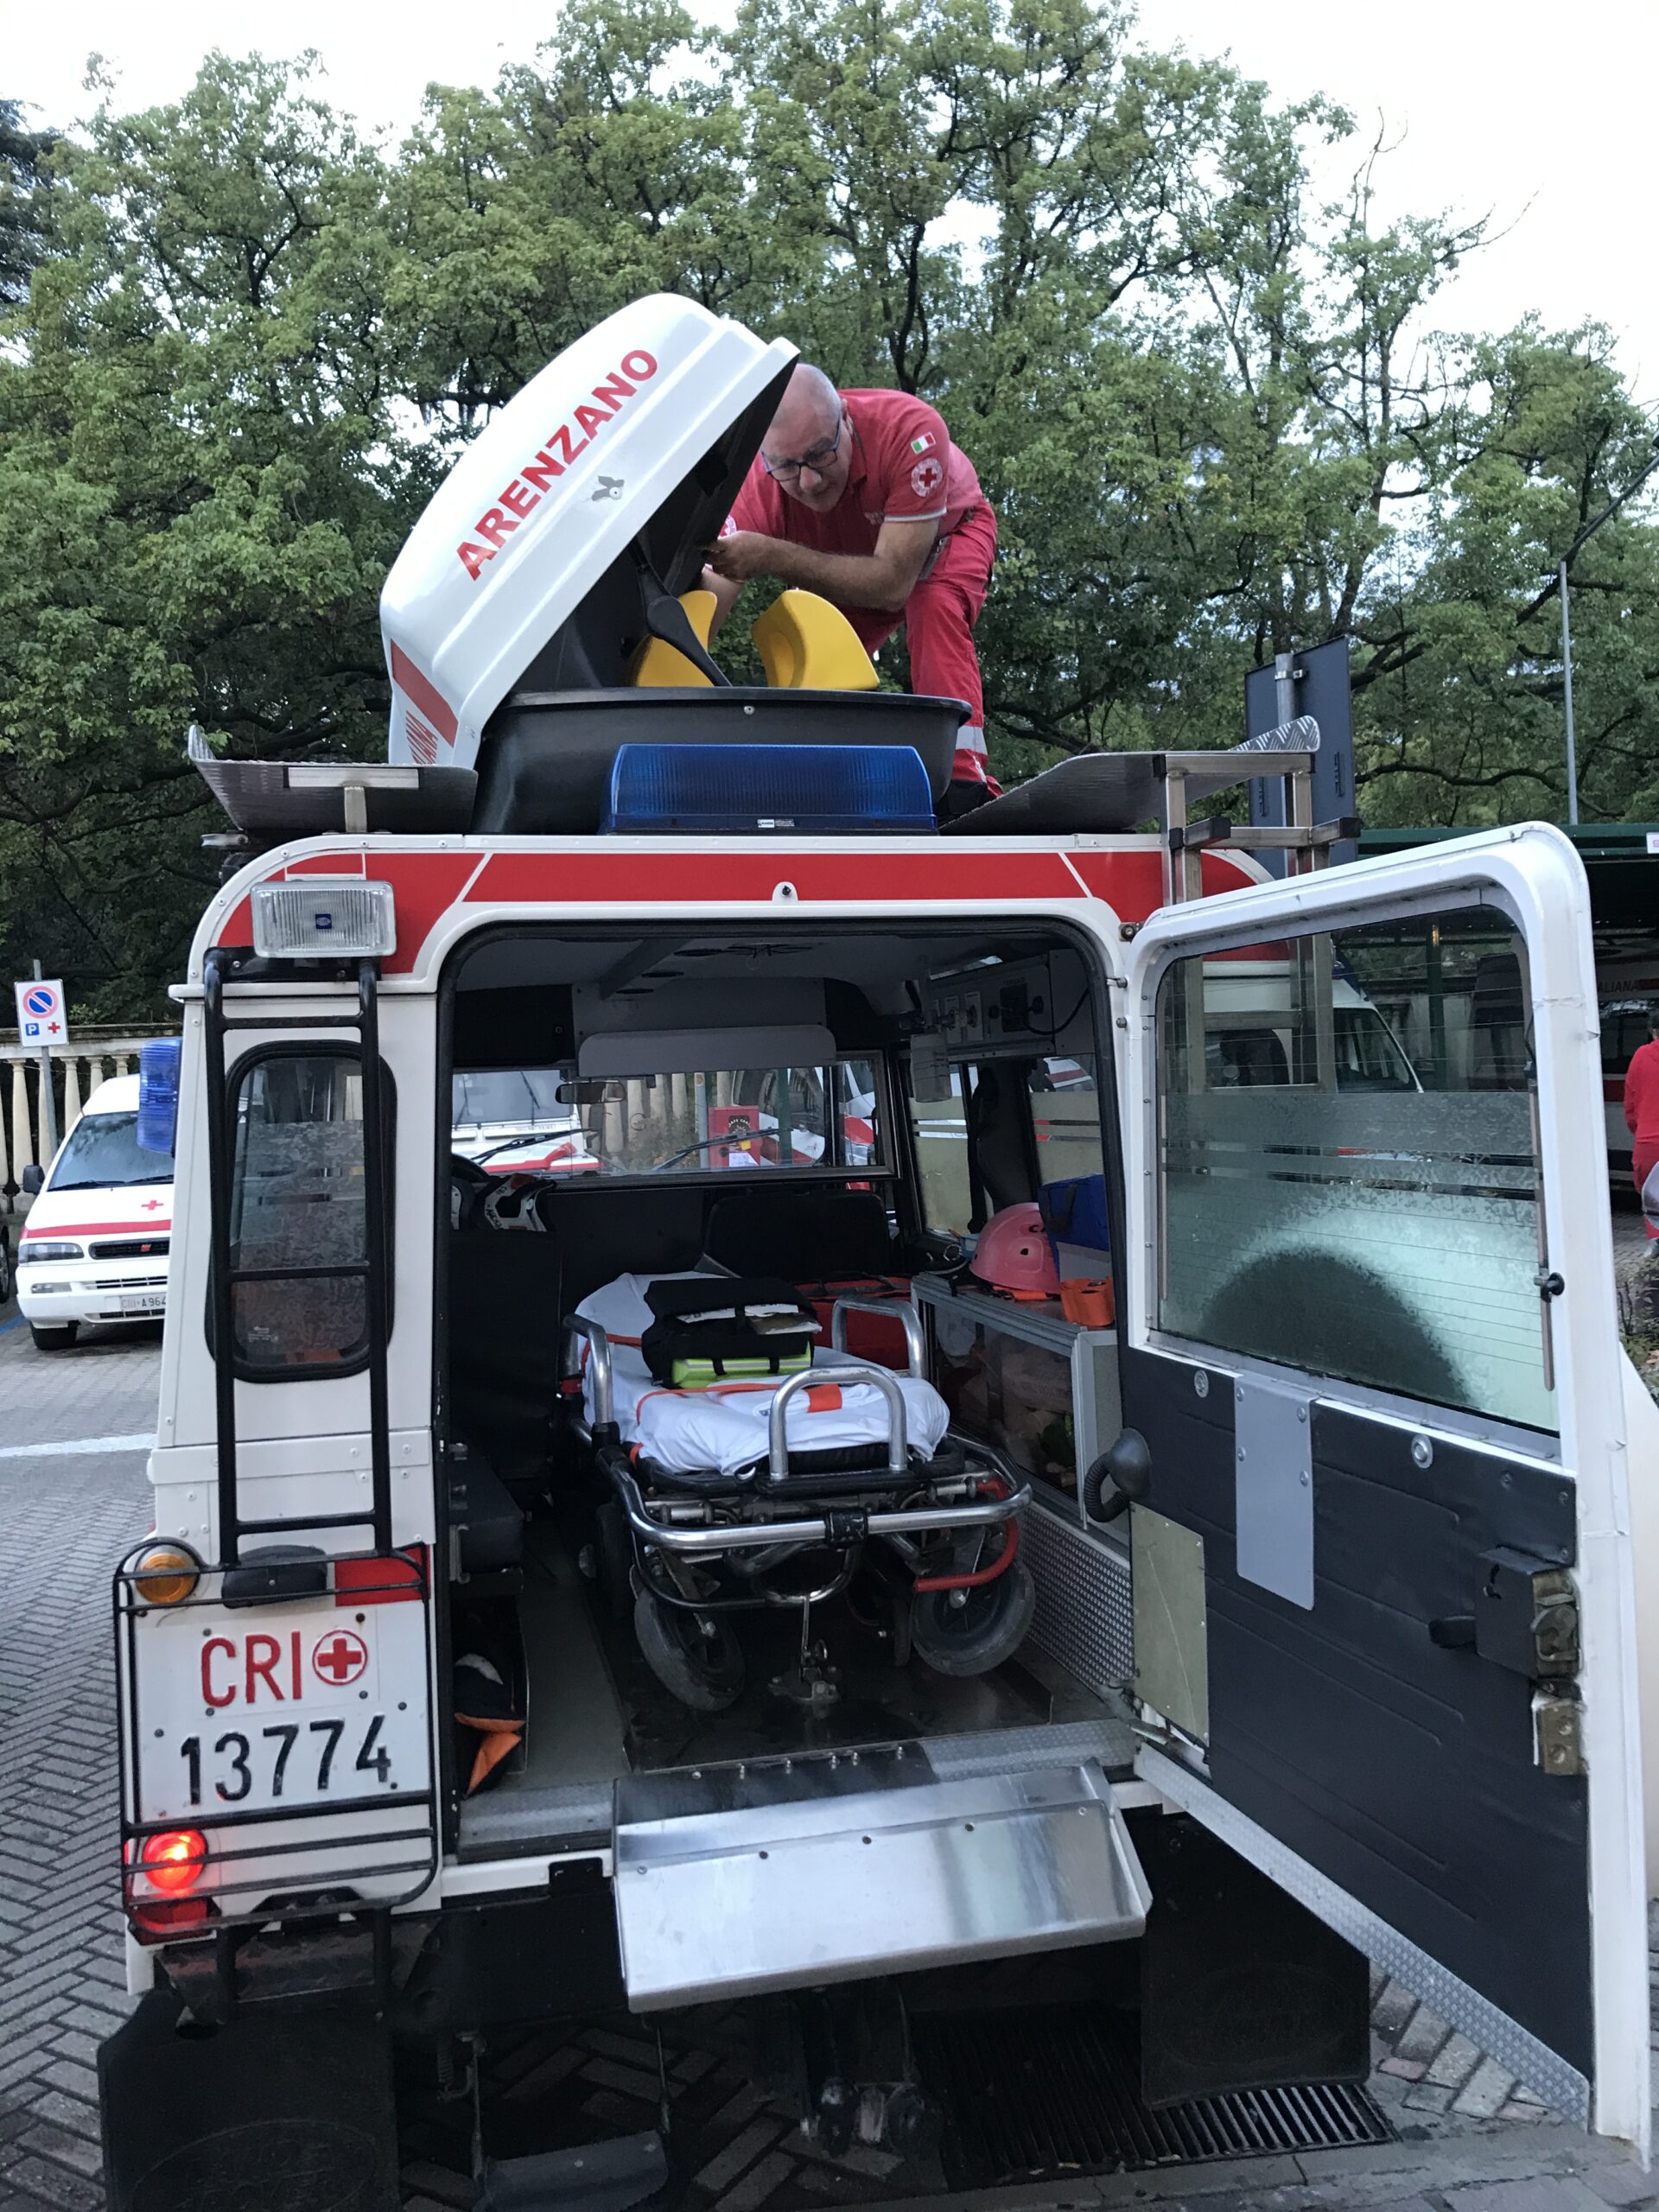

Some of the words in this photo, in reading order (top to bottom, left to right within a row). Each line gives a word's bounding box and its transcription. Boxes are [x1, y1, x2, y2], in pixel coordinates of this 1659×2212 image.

[456, 349, 658, 581] ARENZANO
[200, 1630, 302, 1707] CRI
[180, 1715, 391, 1806] 13774
